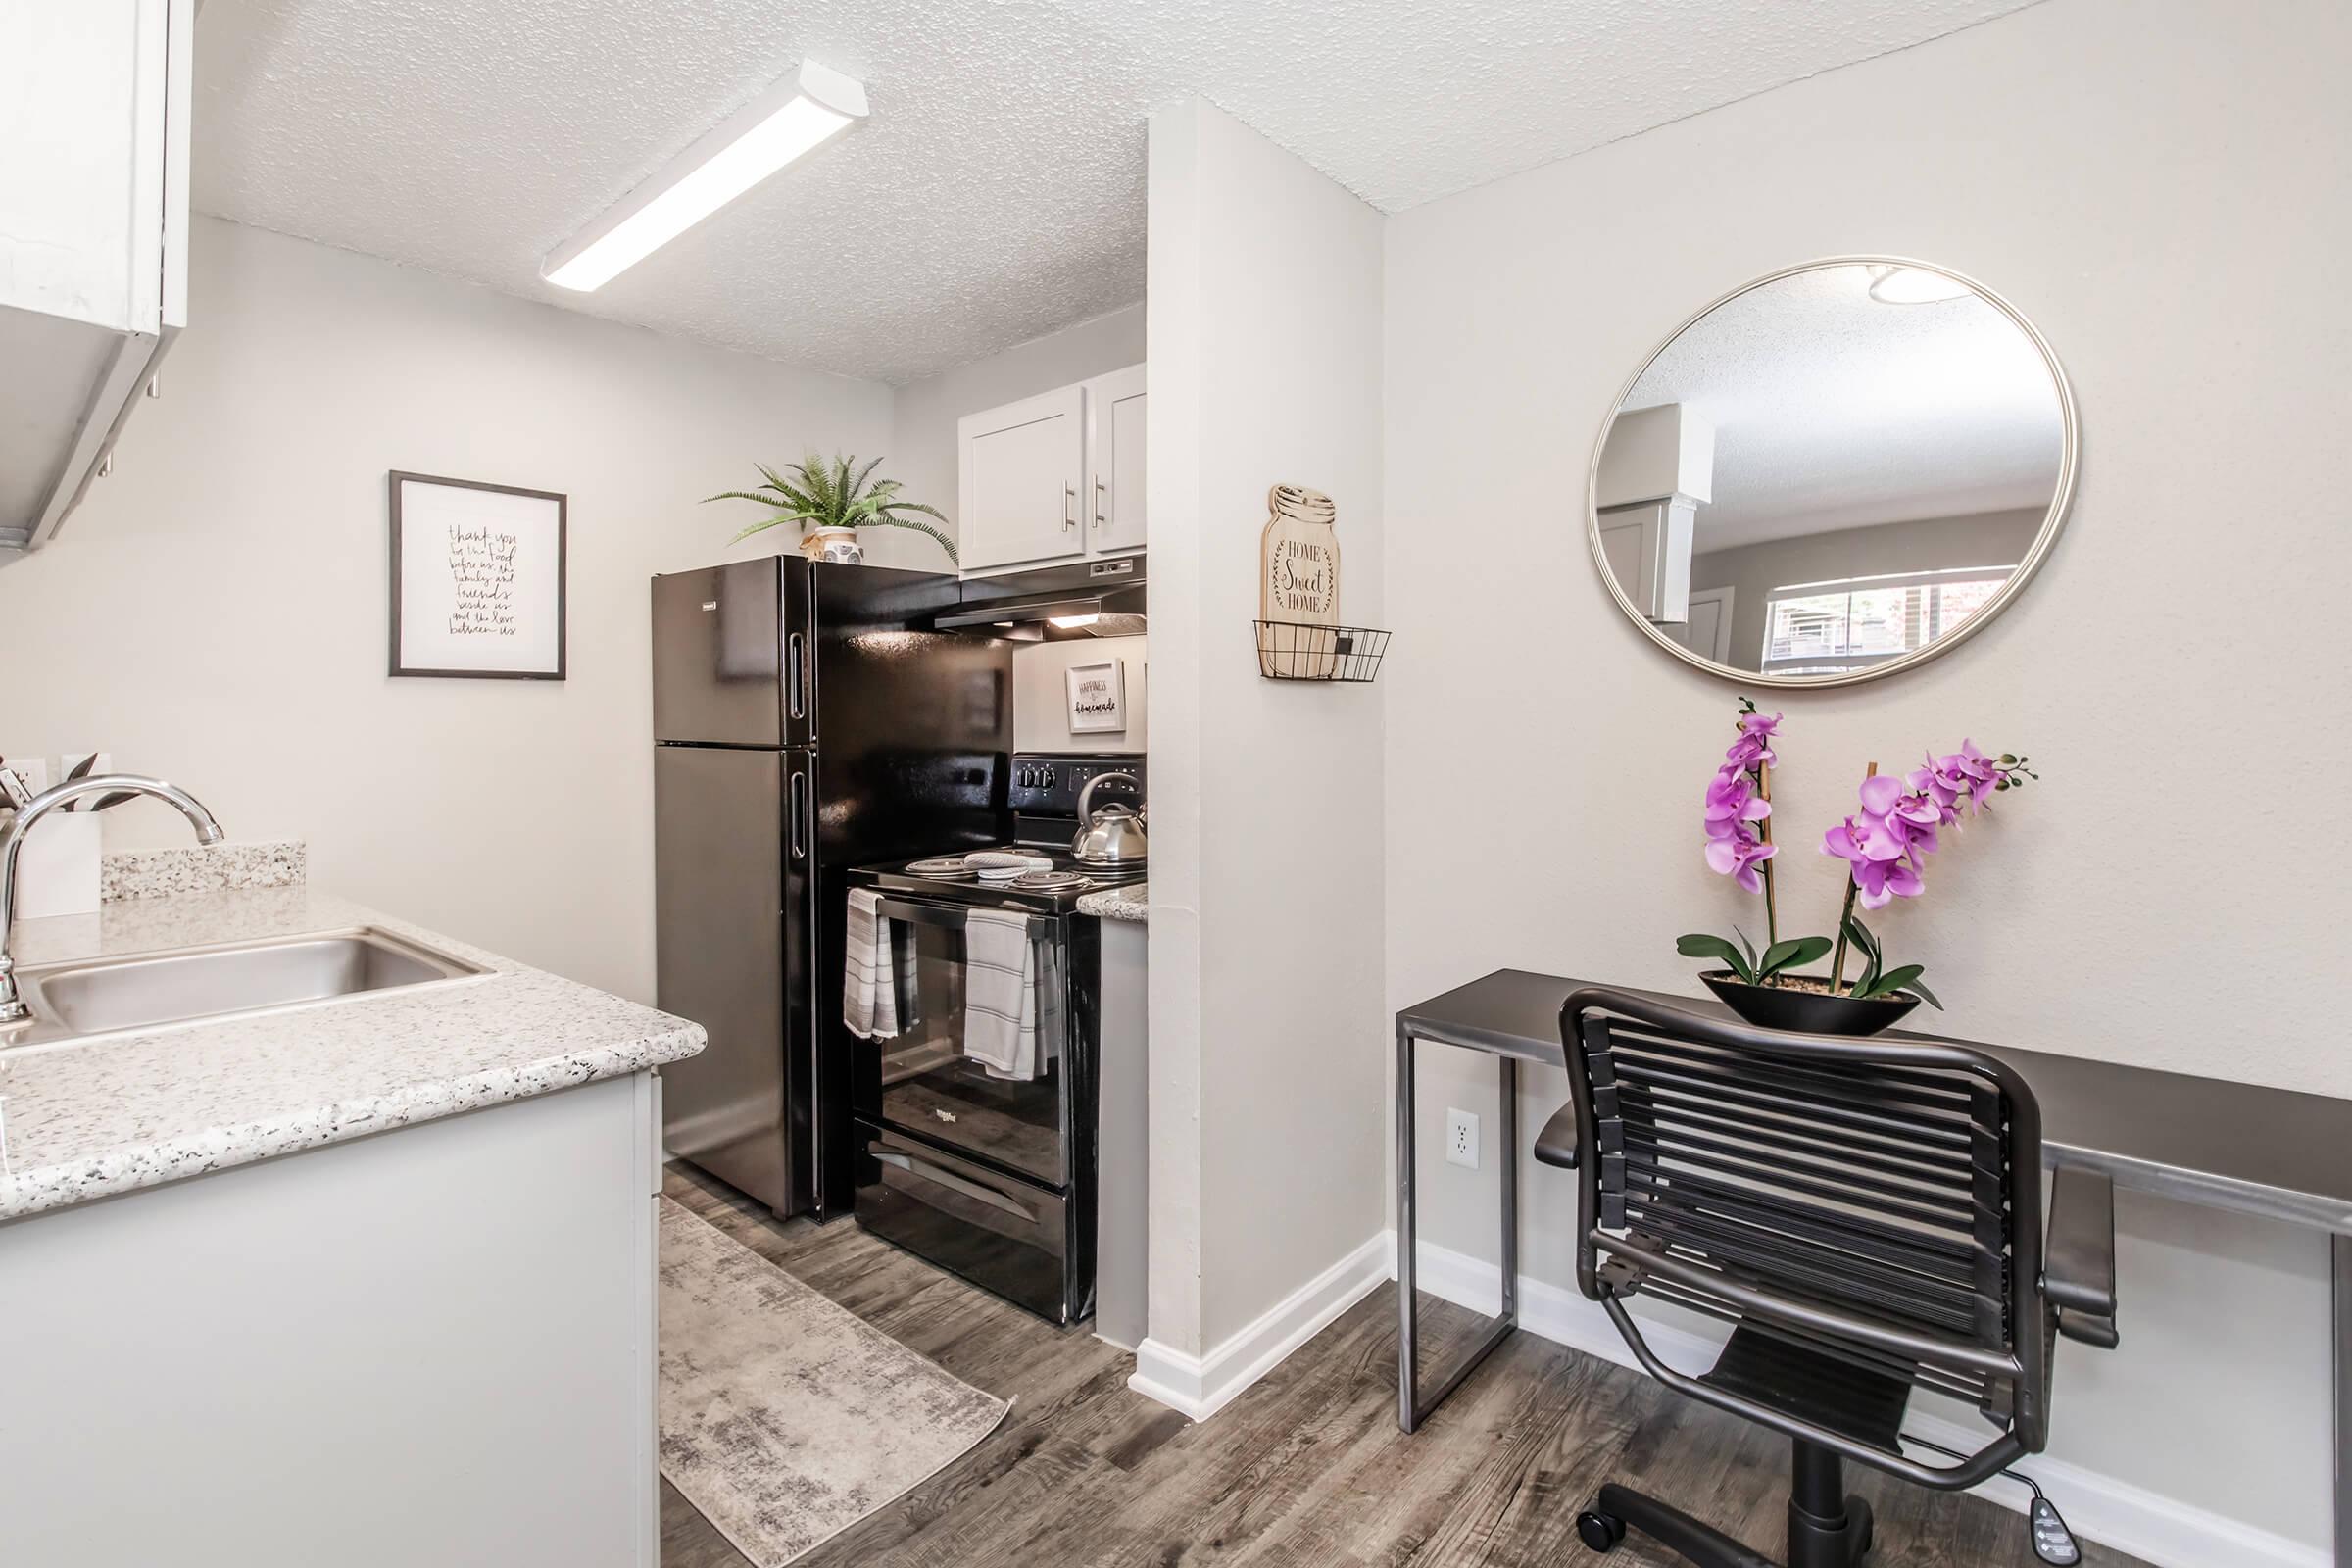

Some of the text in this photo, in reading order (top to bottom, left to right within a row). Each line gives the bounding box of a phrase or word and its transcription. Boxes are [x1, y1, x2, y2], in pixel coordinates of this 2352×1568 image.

[448, 525, 516, 552] thank you
[488, 542, 517, 566] food
[1288, 540, 1321, 563] HOME
[1282, 558, 1325, 594] Sweet
[457, 583, 512, 600] friends
[1288, 593, 1320, 612] HOME
[449, 617, 497, 635] between
[492, 610, 514, 624] love
[1074, 697, 1115, 714] homemade
